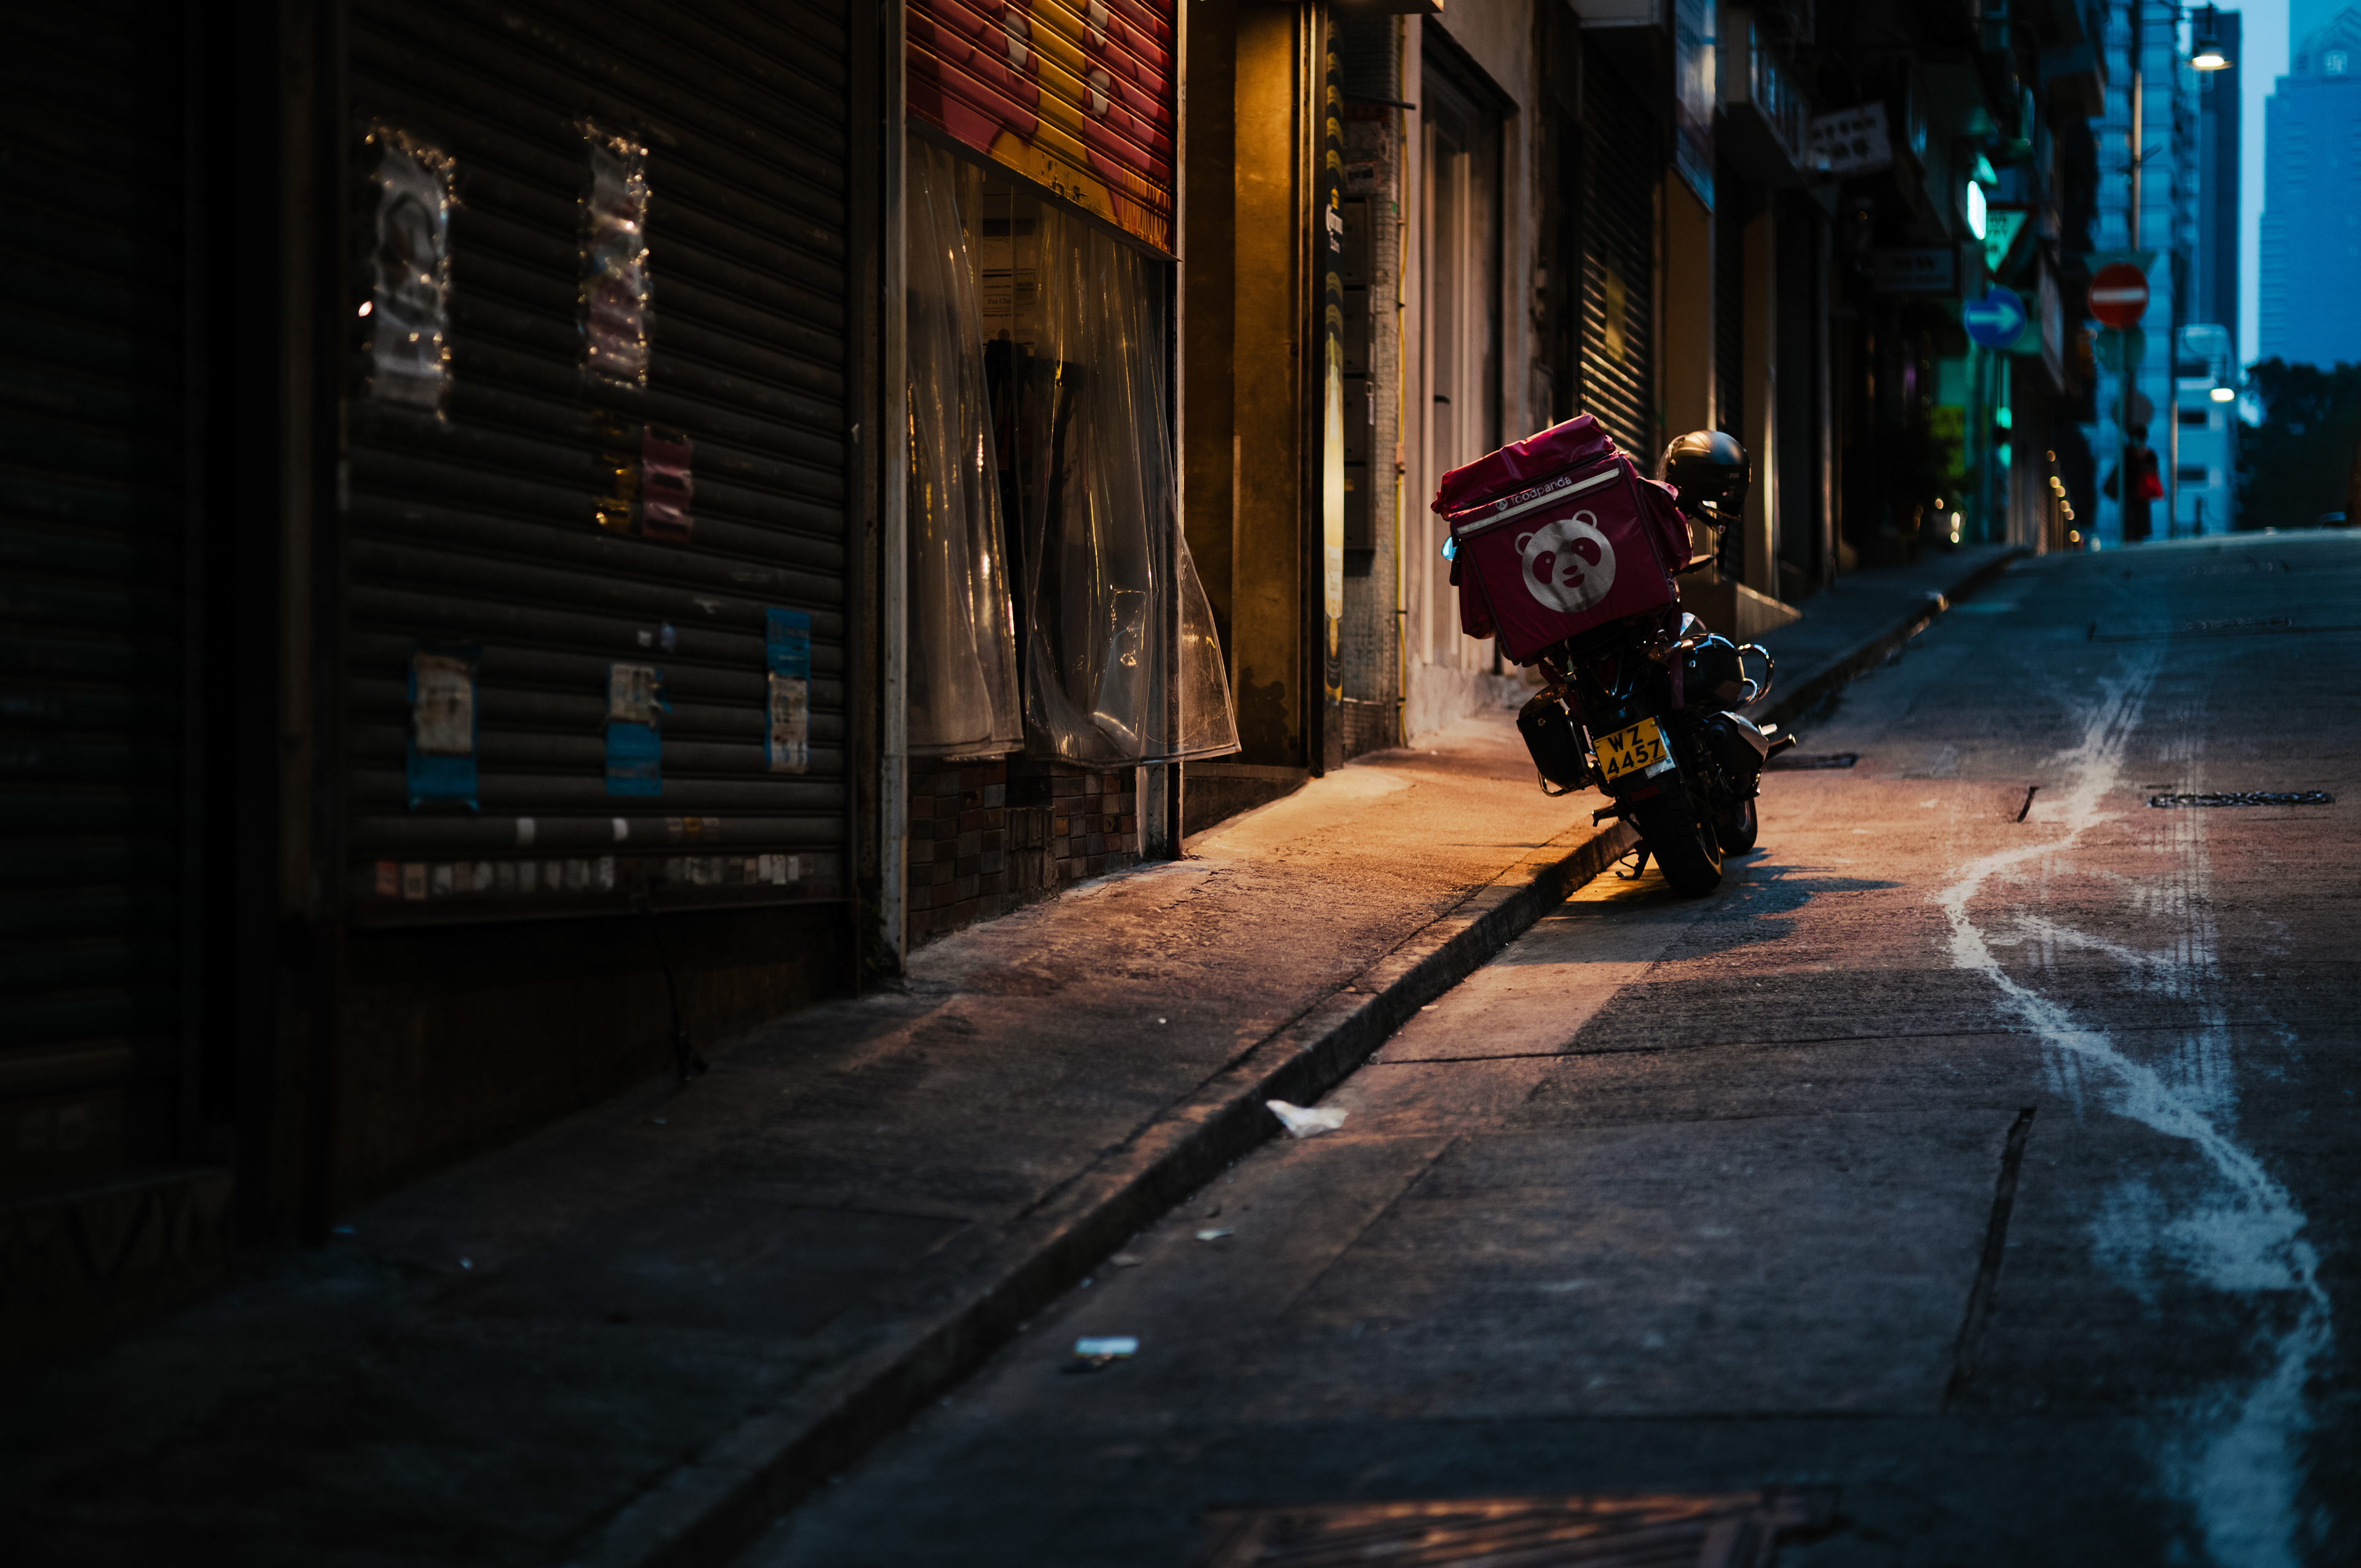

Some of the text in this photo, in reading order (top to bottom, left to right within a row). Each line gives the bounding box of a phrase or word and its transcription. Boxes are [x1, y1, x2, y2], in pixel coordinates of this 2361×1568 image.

[1511, 477, 1572, 505] foodpanda
[1608, 726, 1643, 752] WZ
[1607, 738, 1660, 775] 4457
